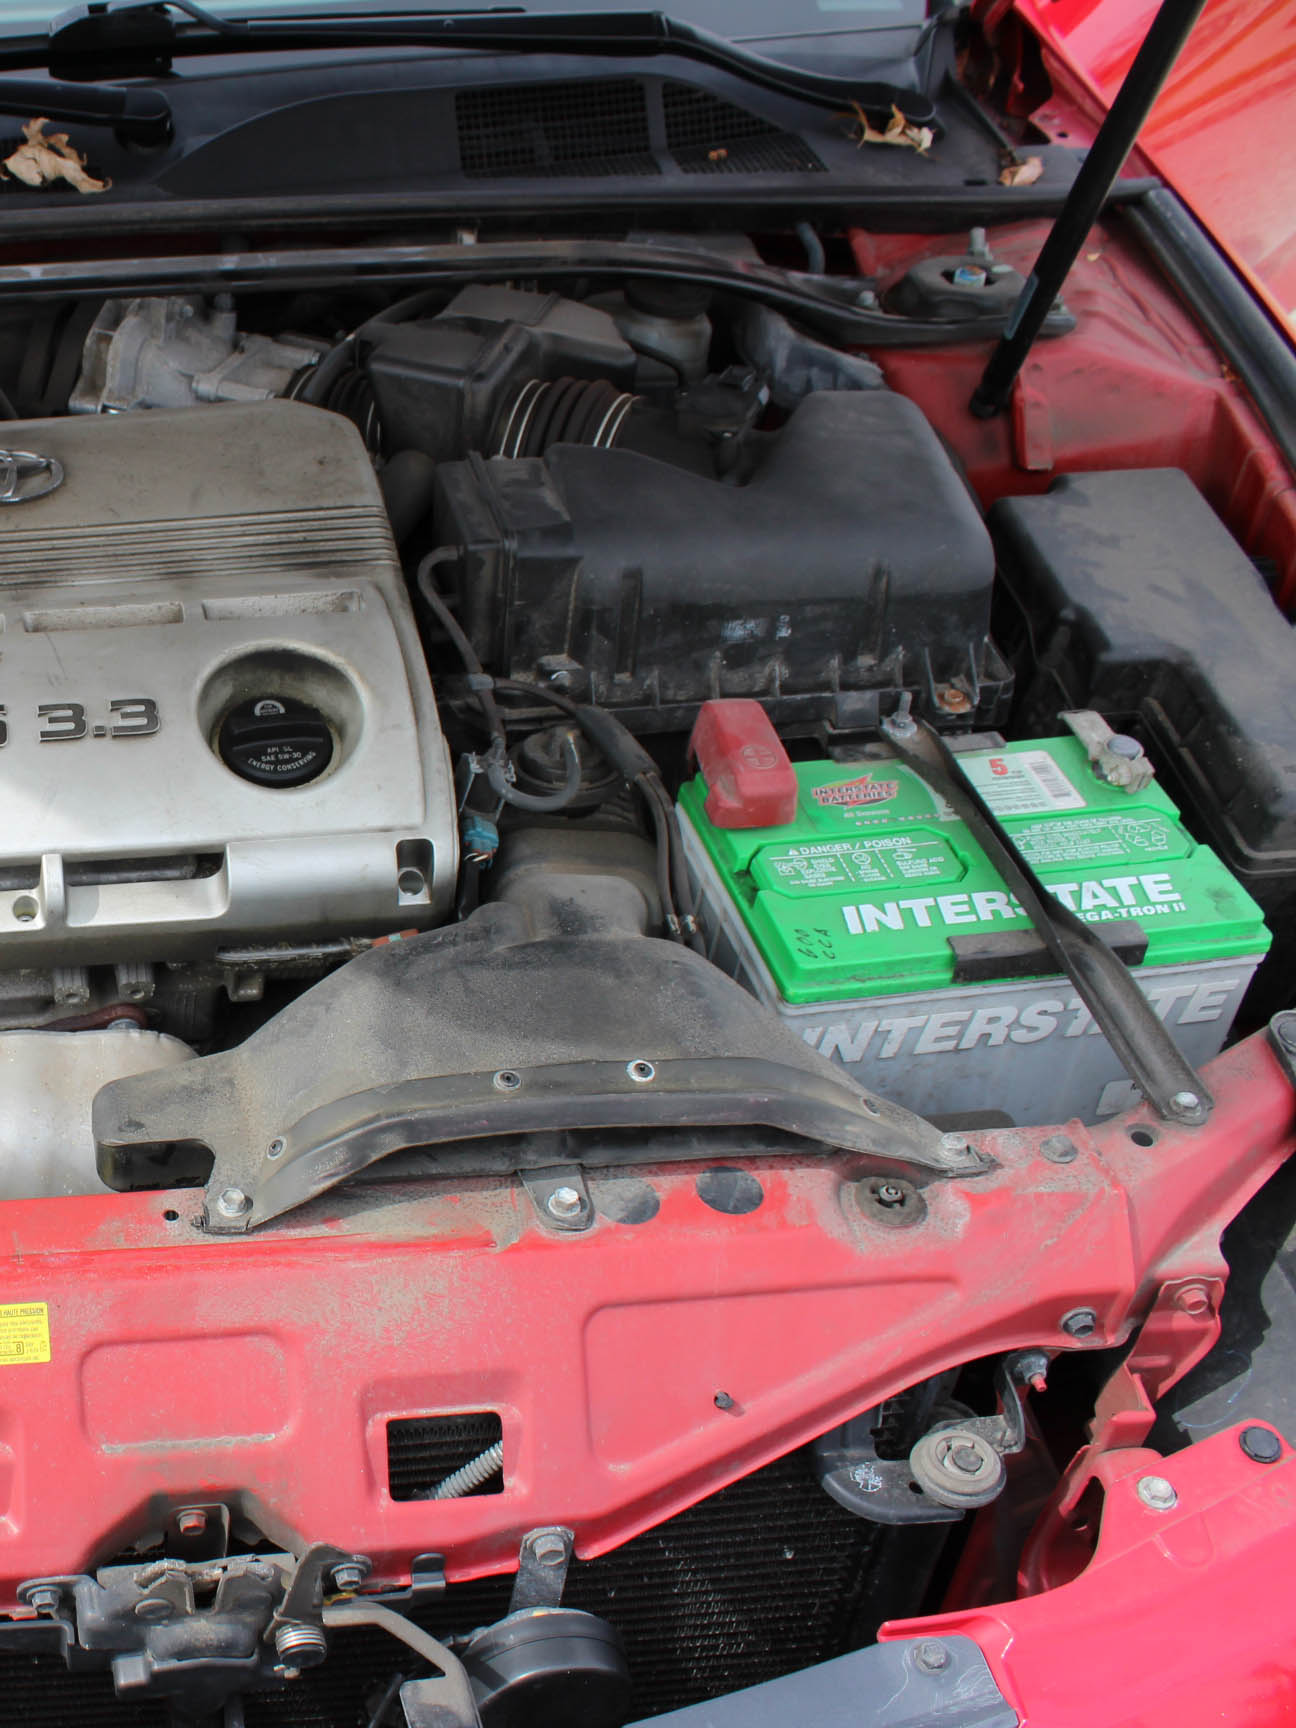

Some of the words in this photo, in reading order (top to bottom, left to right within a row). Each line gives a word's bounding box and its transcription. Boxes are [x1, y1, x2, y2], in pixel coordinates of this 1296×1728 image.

[37, 698, 162, 743] 3.3
[247, 757, 275, 772] ENERGY
[276, 750, 317, 772] CONSERVING
[261, 753, 276, 762] SAE
[989, 758, 1009, 776] 5
[814, 782, 896, 797] INTERSTATE
[821, 790, 893, 804] BATTERIES
[799, 843, 852, 855] DANGER
[864, 837, 912, 849] POISON
[1076, 904, 1171, 922] EGA-TRON
[804, 979, 1240, 1063] NTERSTTE
[20, 1307, 44, 1315] PRESSION
